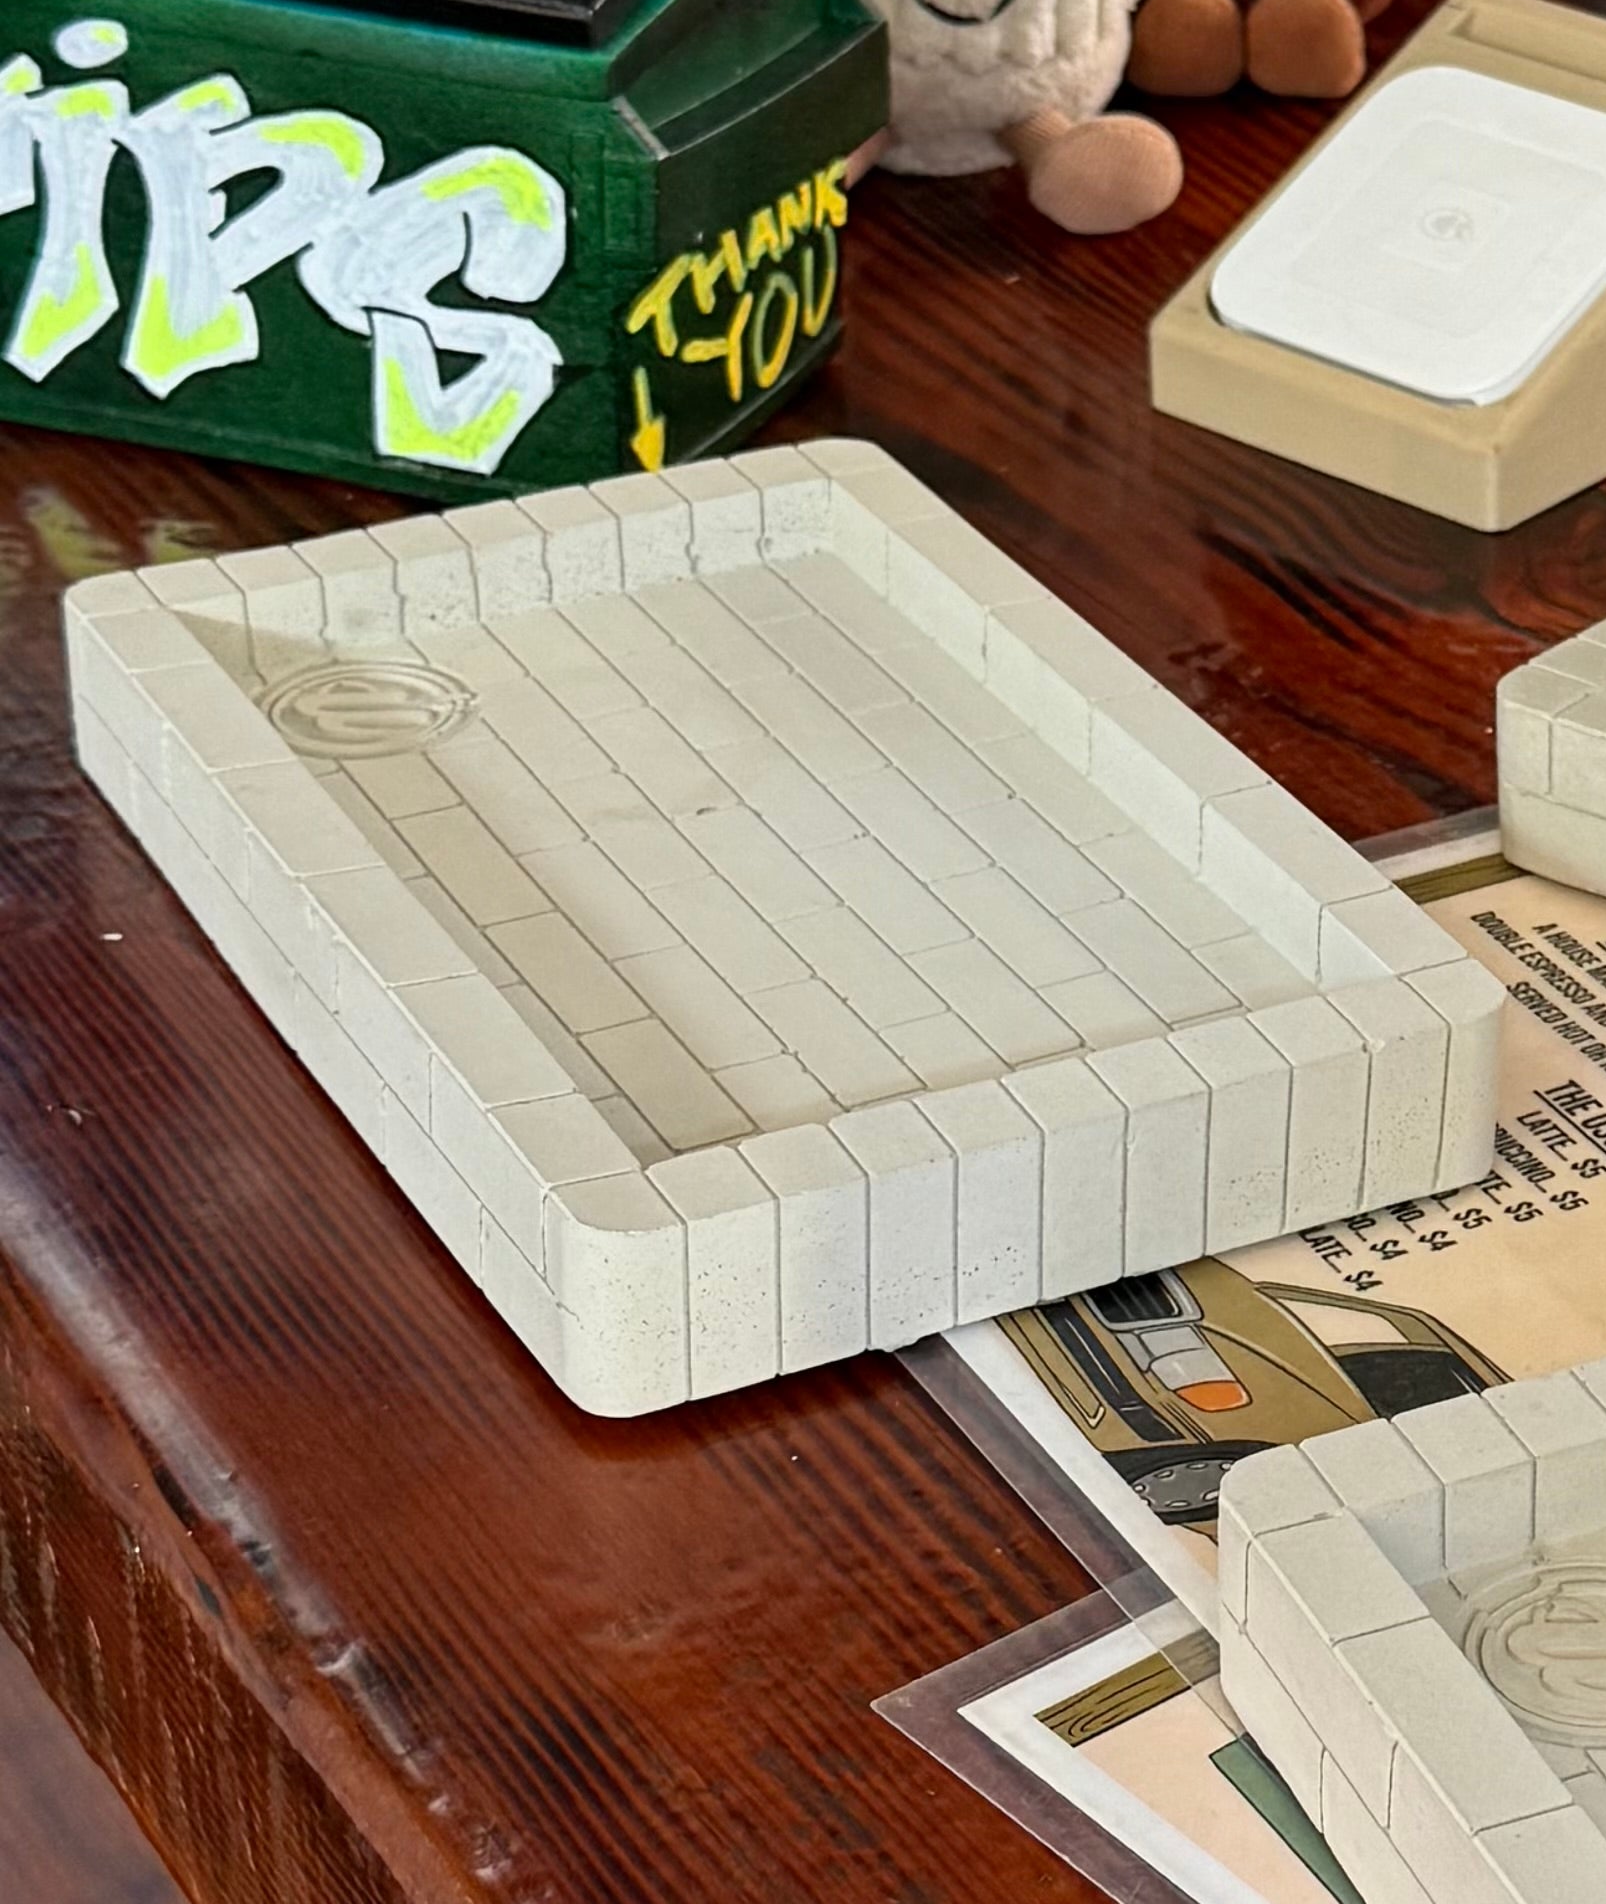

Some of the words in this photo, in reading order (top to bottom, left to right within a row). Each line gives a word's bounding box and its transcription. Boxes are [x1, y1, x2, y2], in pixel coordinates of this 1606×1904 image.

[0, 18, 566, 477] iPS
[625, 158, 848, 358] THANK
[682, 224, 837, 402] YOU
[1470, 910, 1534, 955] DOUBLE
[1519, 950, 1597, 1005] ESPRESSO
[1532, 923, 1557, 936] A
[1549, 931, 1602, 969] HOUSE
[1506, 981, 1568, 1025] SERVED
[1554, 1019, 1596, 1049] HOT
[1544, 1079, 1604, 1117] THE
[1453, 1208, 1493, 1230] $5
[1503, 1201, 1544, 1222] $5
[1549, 1190, 1590, 1211] $5
